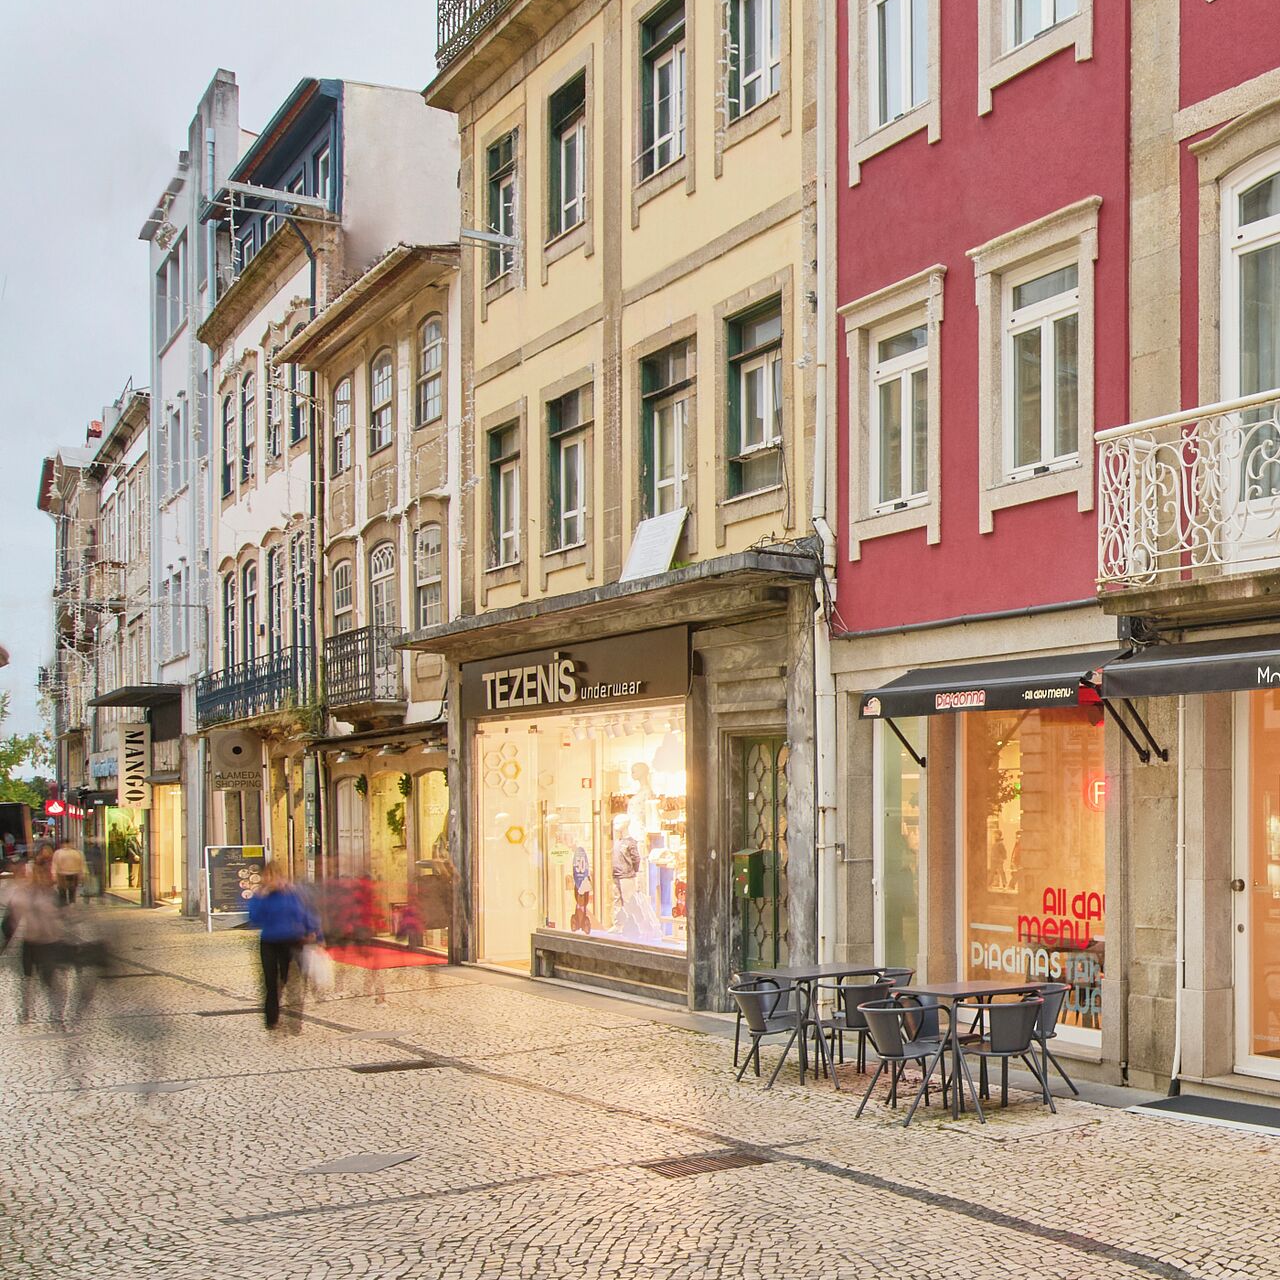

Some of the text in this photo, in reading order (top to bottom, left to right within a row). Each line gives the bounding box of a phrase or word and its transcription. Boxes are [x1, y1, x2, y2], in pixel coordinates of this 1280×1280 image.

[580, 680, 642, 700] underwear
[1047, 687, 1071, 698] menu
[125, 730, 145, 802] MANGO
[215, 771, 262, 780] ALAMEDA
[215, 780, 262, 788] SHOPPING
[1043, 887, 1067, 917] All
[1018, 915, 1090, 951] menu
